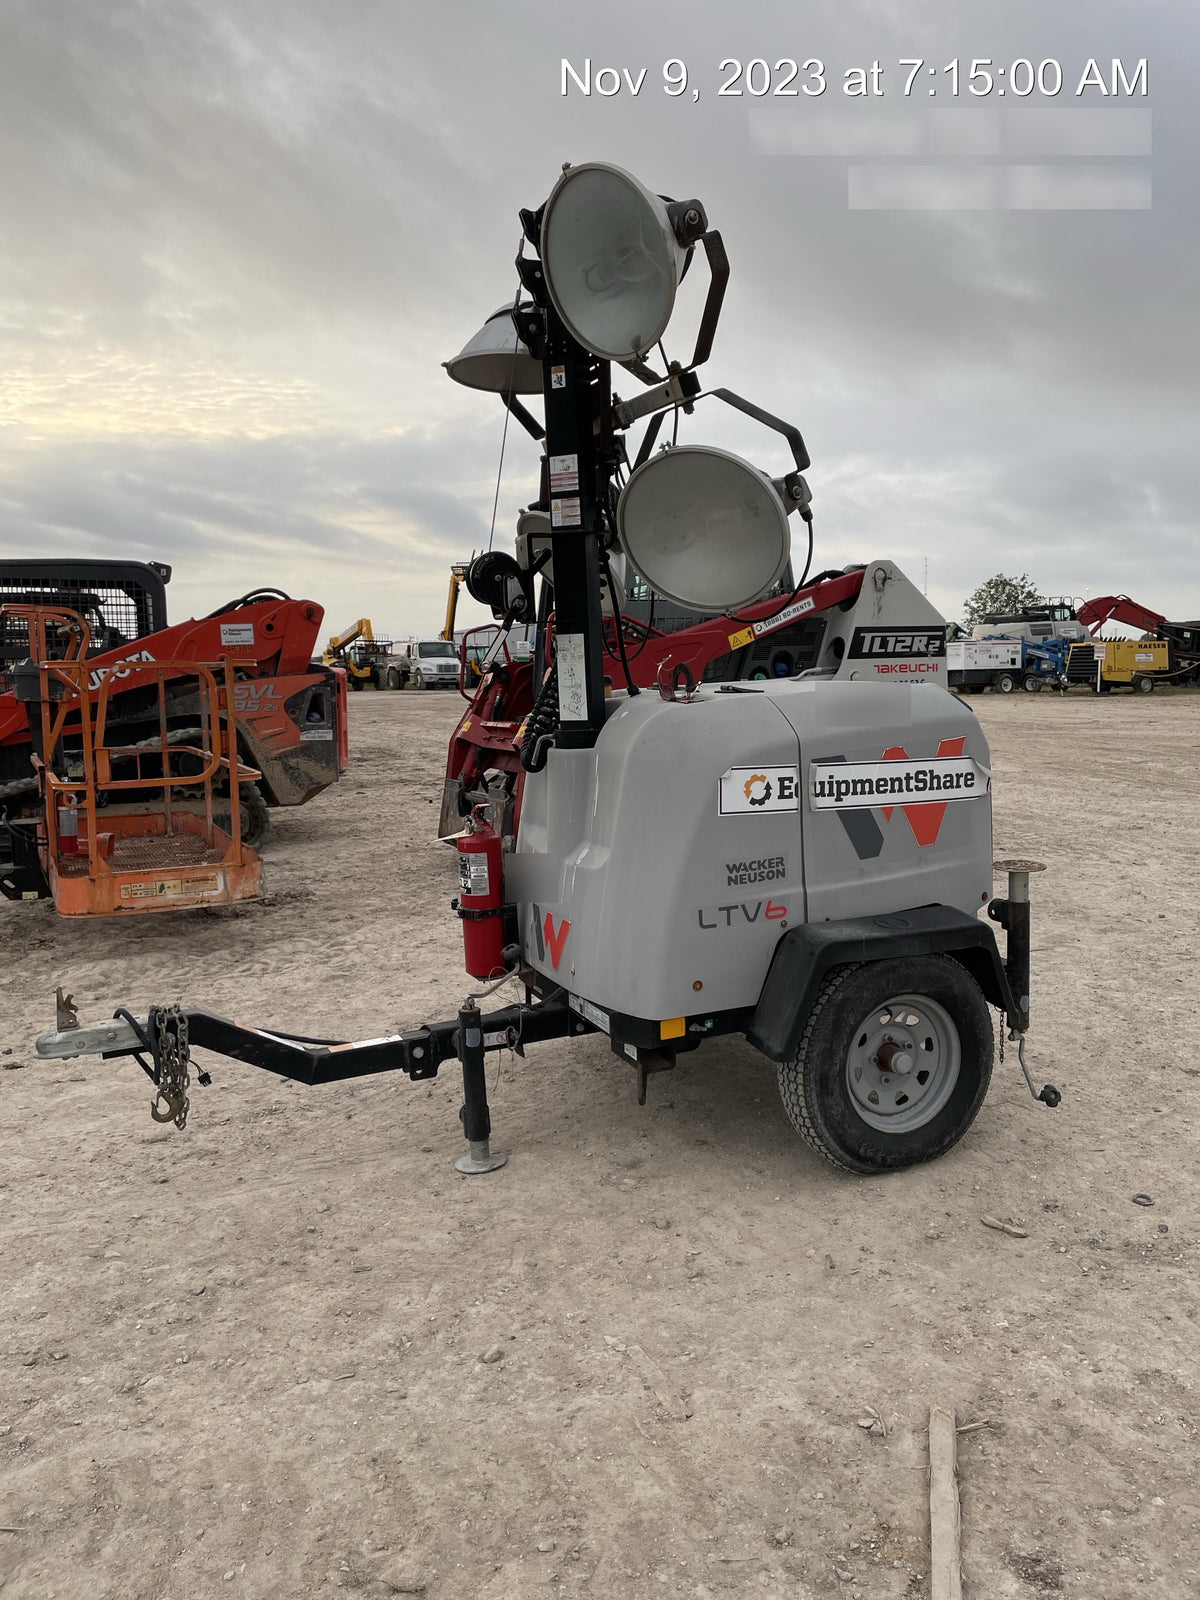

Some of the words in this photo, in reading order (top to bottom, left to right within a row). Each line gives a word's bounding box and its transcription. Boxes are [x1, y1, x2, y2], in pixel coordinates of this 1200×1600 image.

[873, 663, 939, 674] TAKEUCHI
[233, 684, 284, 700] SVL
[725, 857, 786, 875] WACKER
[727, 867, 786, 887] NEUSON
[698, 899, 788, 930] LTV6
